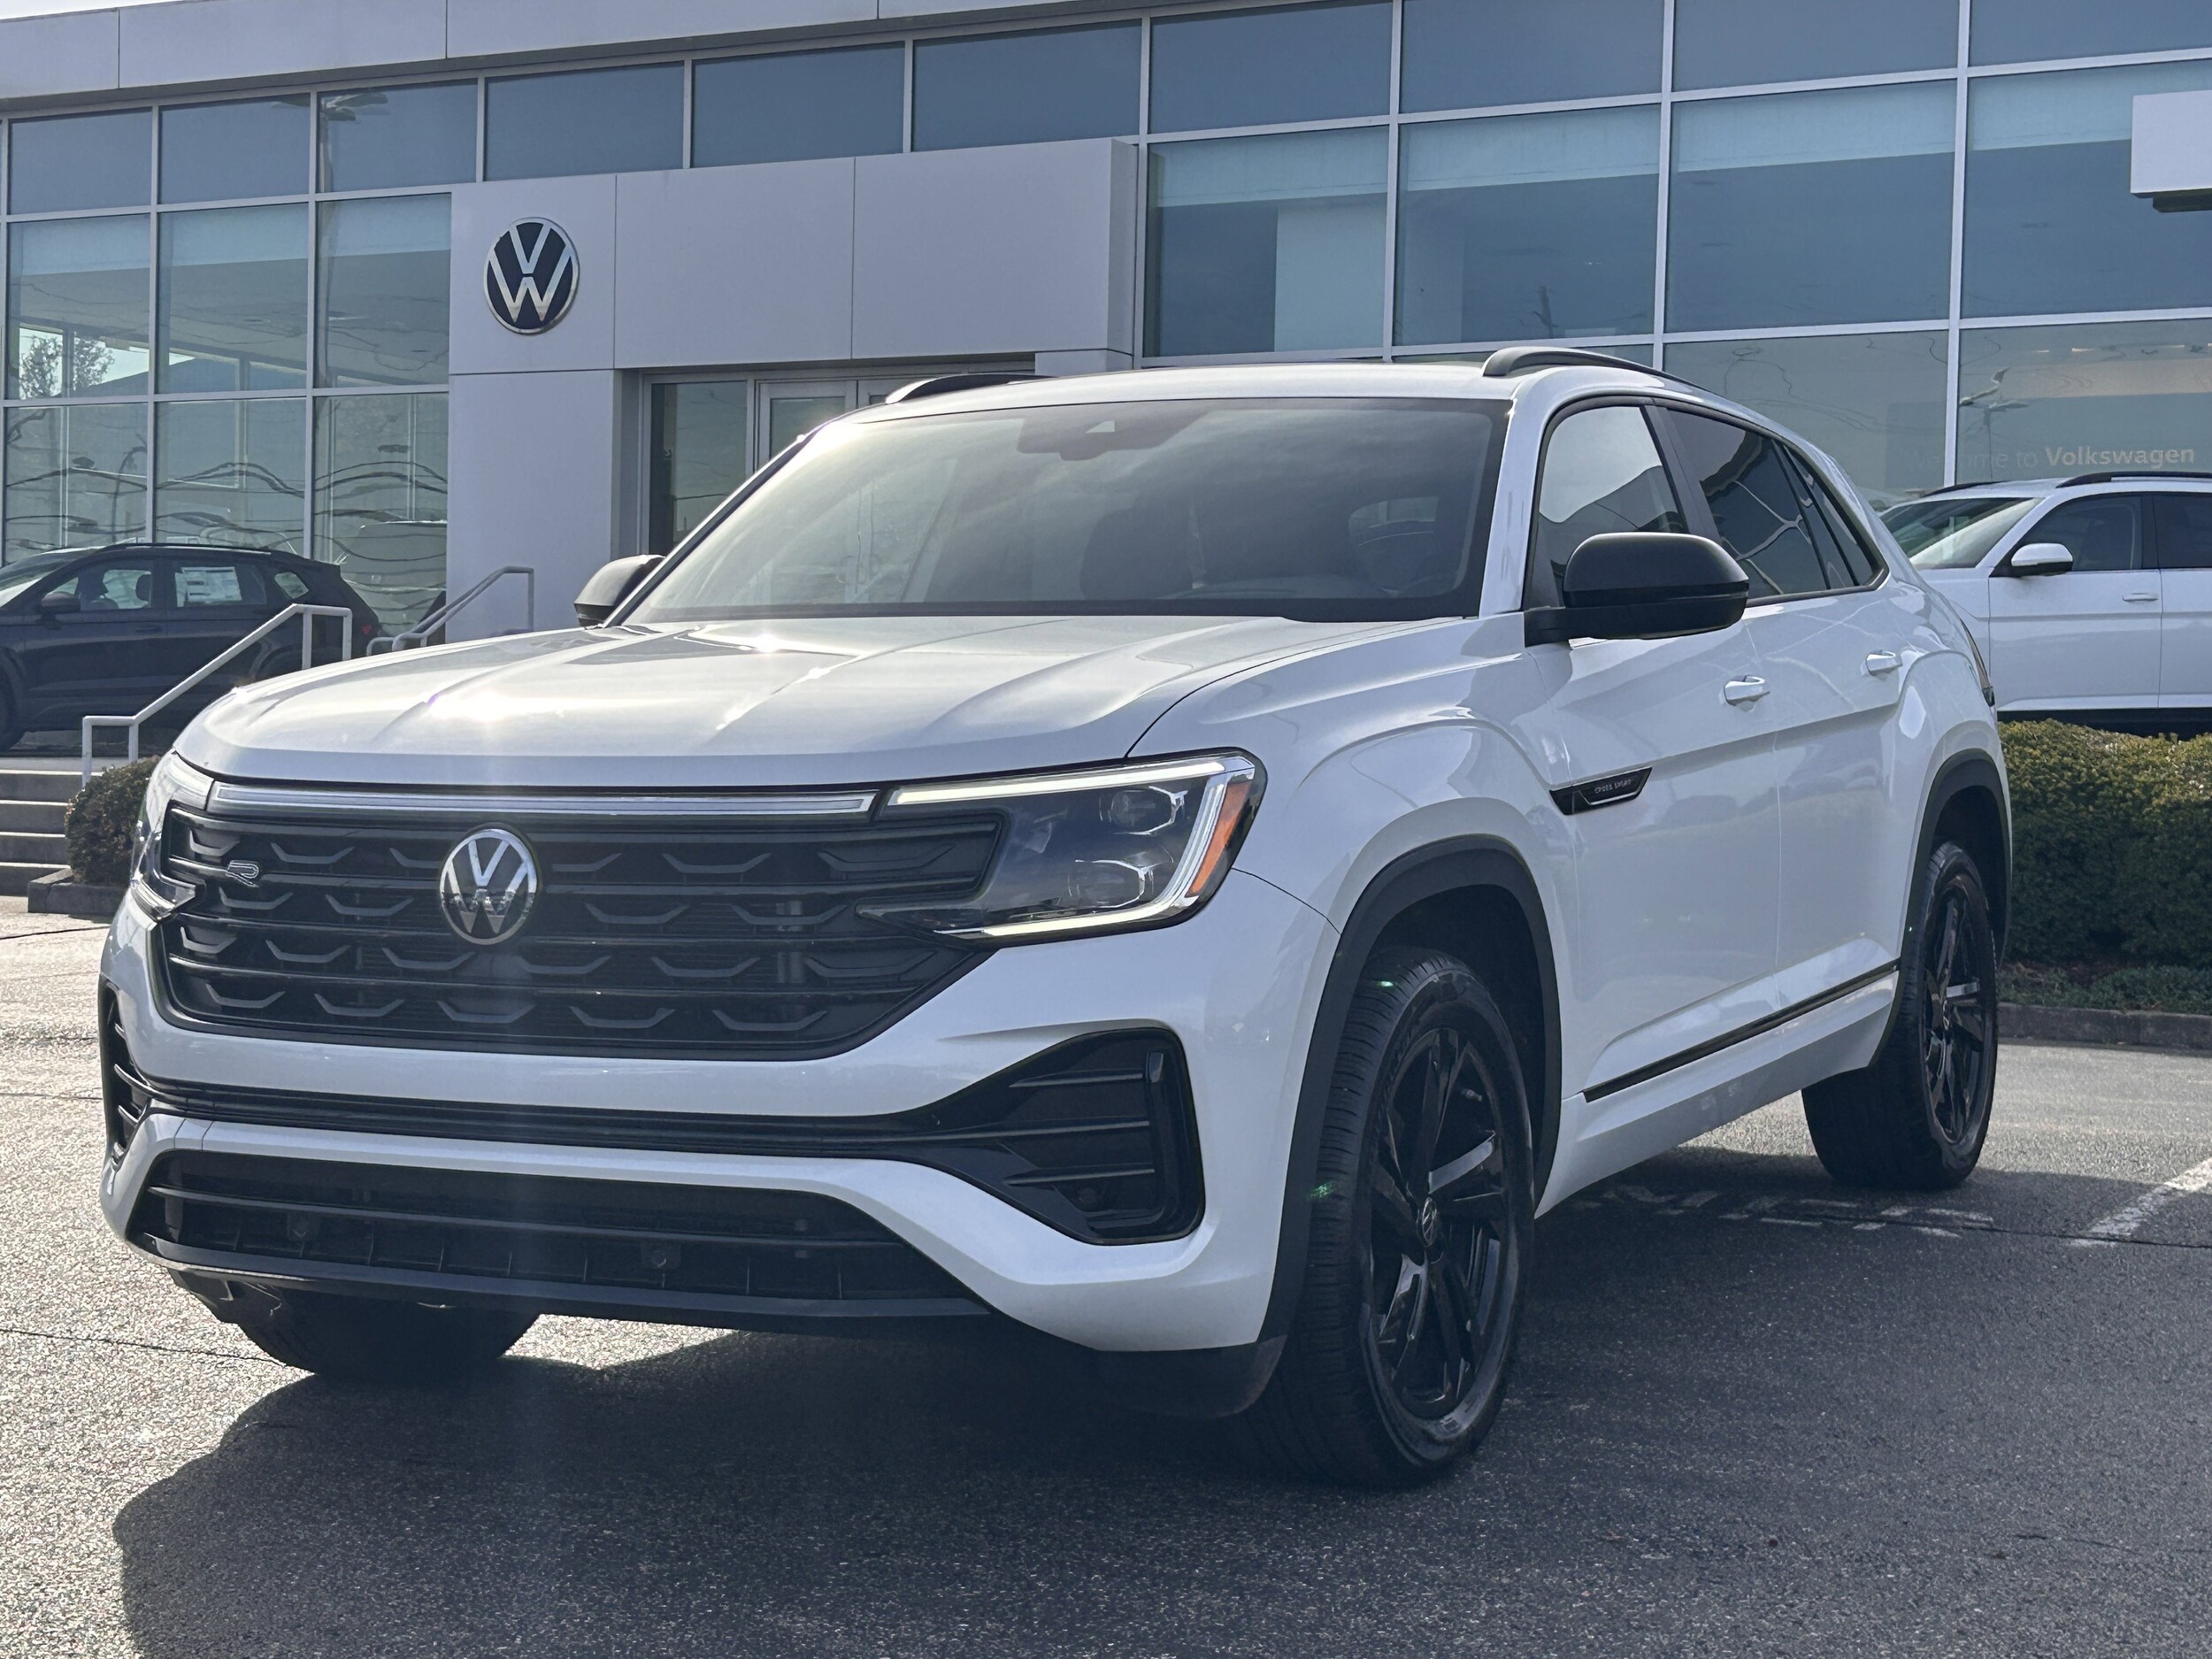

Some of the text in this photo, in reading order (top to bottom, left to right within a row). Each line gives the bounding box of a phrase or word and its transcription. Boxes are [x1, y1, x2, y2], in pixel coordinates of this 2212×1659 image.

[486, 219, 578, 326] VW
[2016, 451, 2039, 468] to
[2045, 446, 2195, 469] Volkswagen
[442, 832, 535, 938] VW
